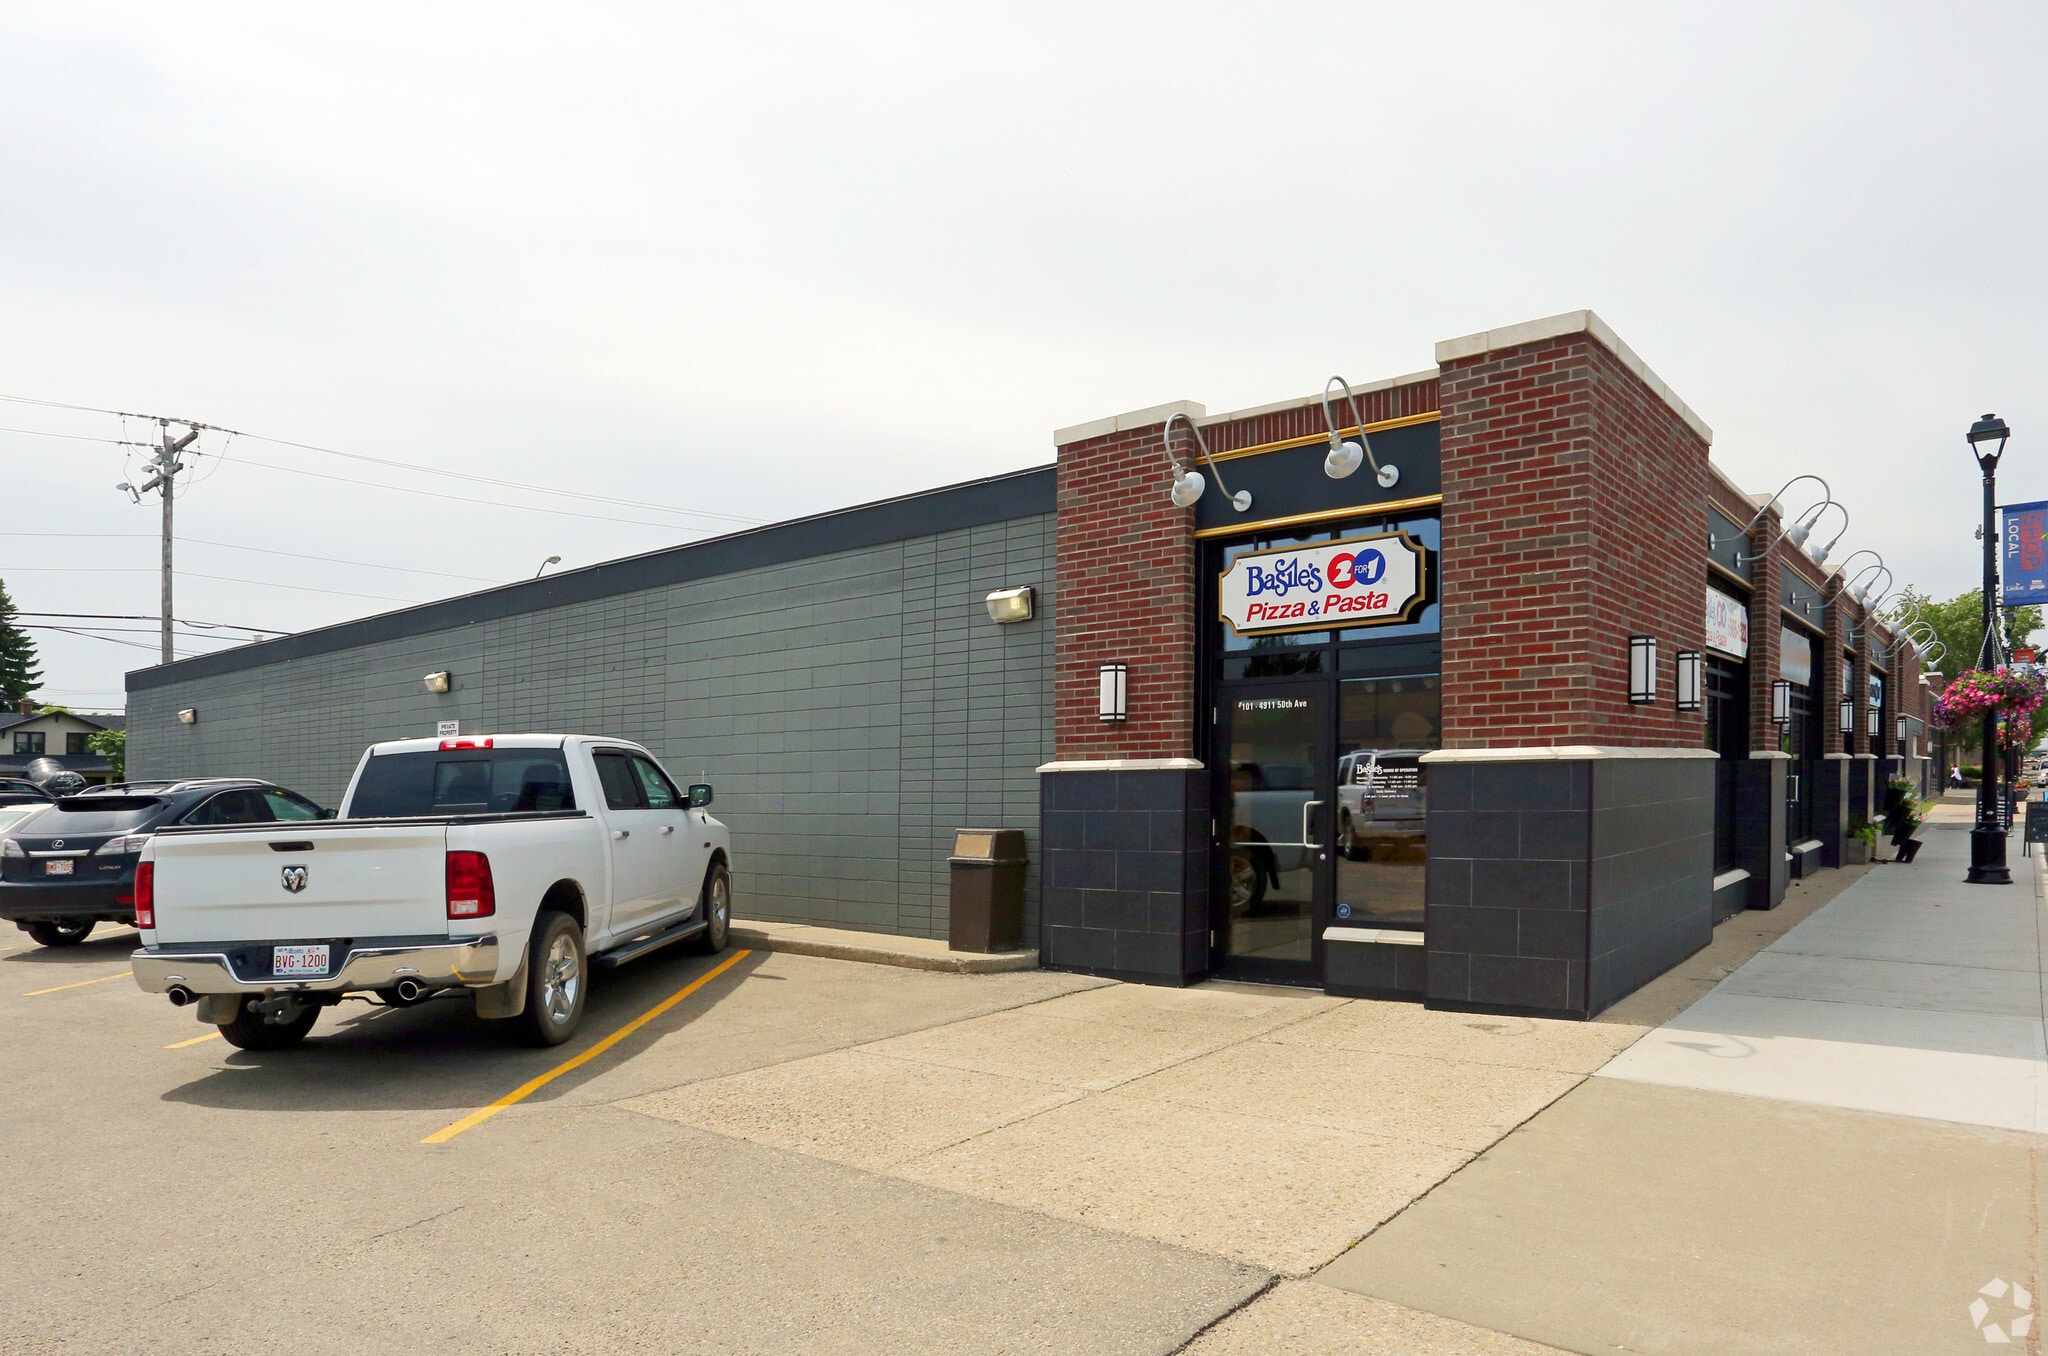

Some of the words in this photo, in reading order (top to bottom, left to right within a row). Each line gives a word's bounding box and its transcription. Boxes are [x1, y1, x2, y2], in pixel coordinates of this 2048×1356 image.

[2008, 518, 2020, 559] LOCAL
[2022, 512, 2043, 569] SHOP
[1246, 557, 1323, 597] Basile's
[1332, 560, 1353, 583] 2
[1354, 564, 1368, 574] FOR
[1367, 555, 1380, 579] 1
[1246, 602, 1306, 622] Pizza
[1307, 600, 1321, 616] &
[1323, 591, 1389, 614] Pasta
[1259, 701, 1275, 710] 4911
[1277, 700, 1293, 709] 50th
[1294, 699, 1307, 708] Ave
[275, 953, 327, 969] BVG-1200
